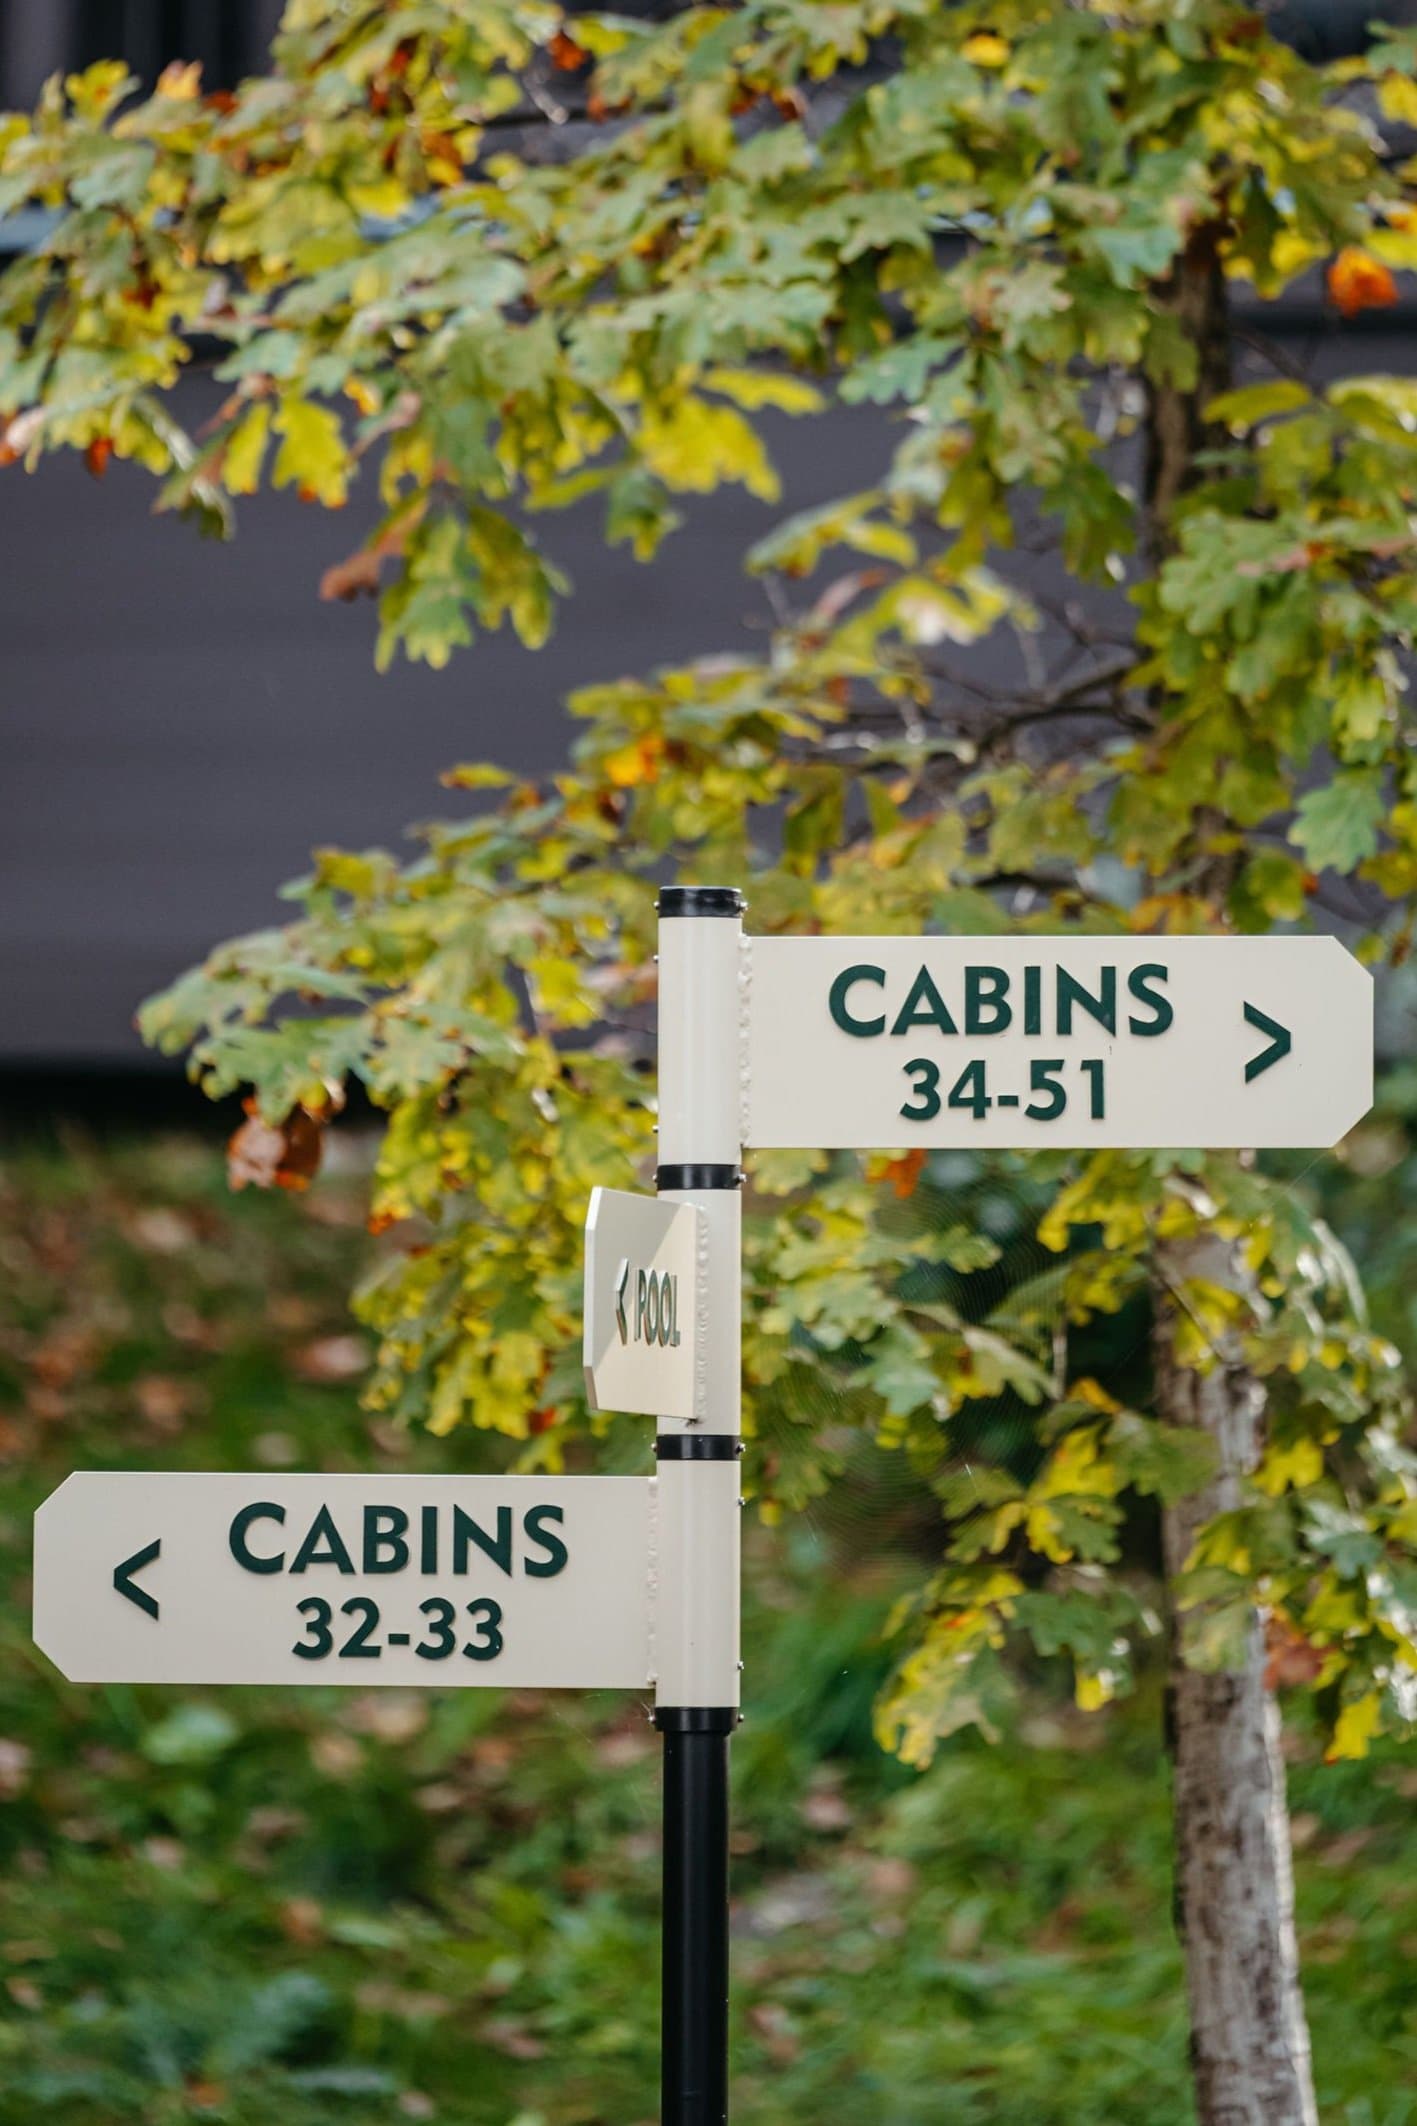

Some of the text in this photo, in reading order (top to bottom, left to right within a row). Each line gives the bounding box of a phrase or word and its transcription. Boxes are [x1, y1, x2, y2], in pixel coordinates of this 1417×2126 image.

[828, 963, 1174, 1040] CABINS
[899, 1058, 1105, 1122] 34-51
[634, 1268, 680, 1348] POOL
[228, 1501, 569, 1579] CABINS
[291, 1596, 504, 1663] 32-33
